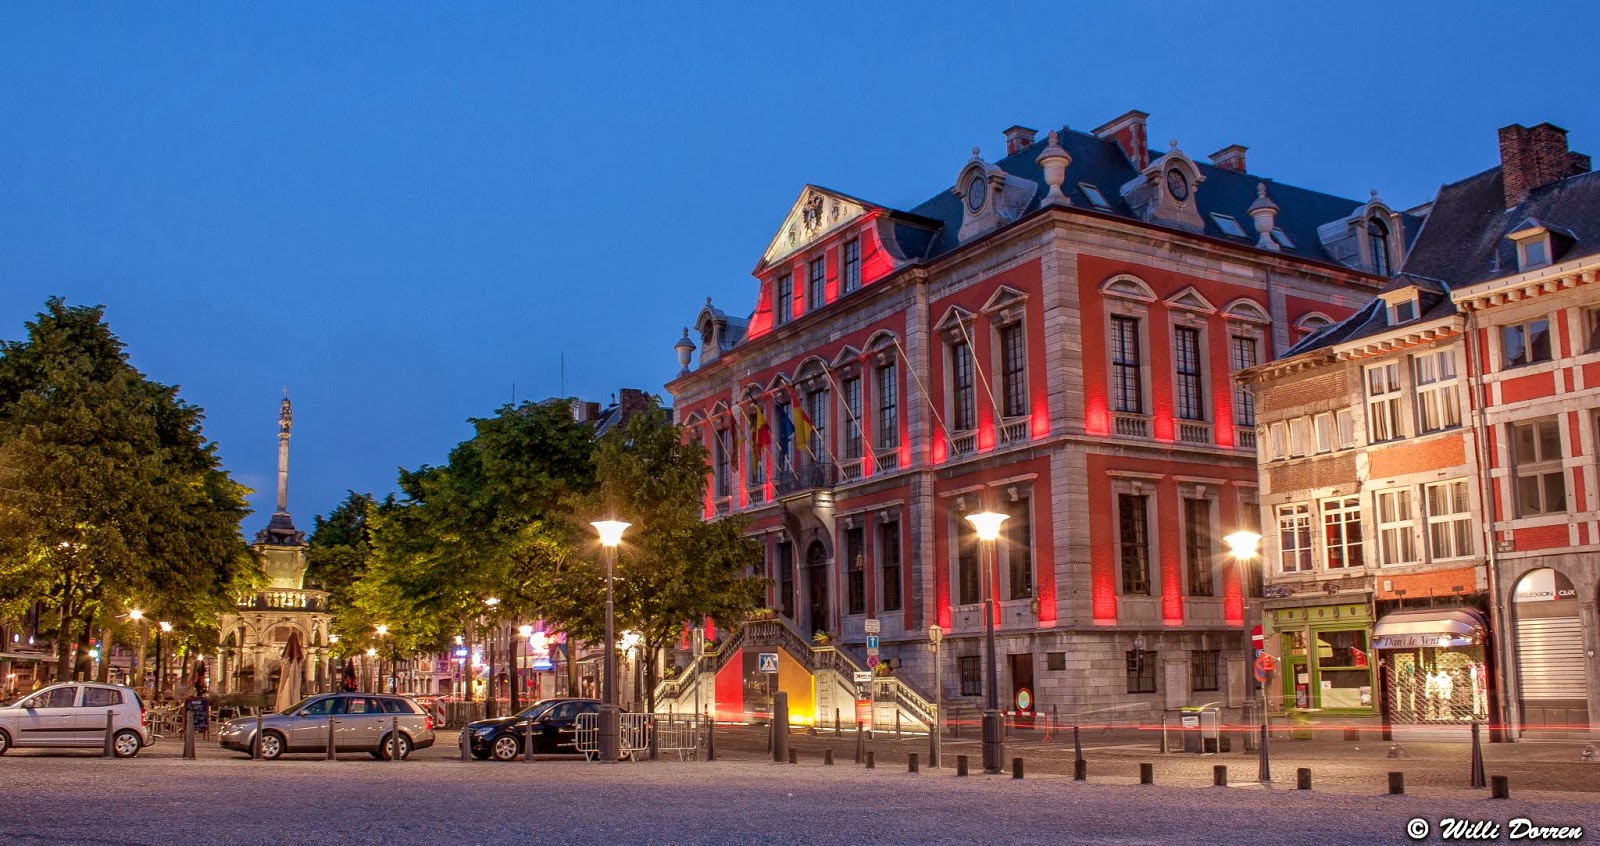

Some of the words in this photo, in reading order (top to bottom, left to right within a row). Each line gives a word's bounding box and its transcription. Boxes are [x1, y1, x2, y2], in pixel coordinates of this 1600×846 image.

[1384, 637, 1407, 647] Dans
[1408, 636, 1418, 646] le
[1420, 635, 1441, 645] Vent
